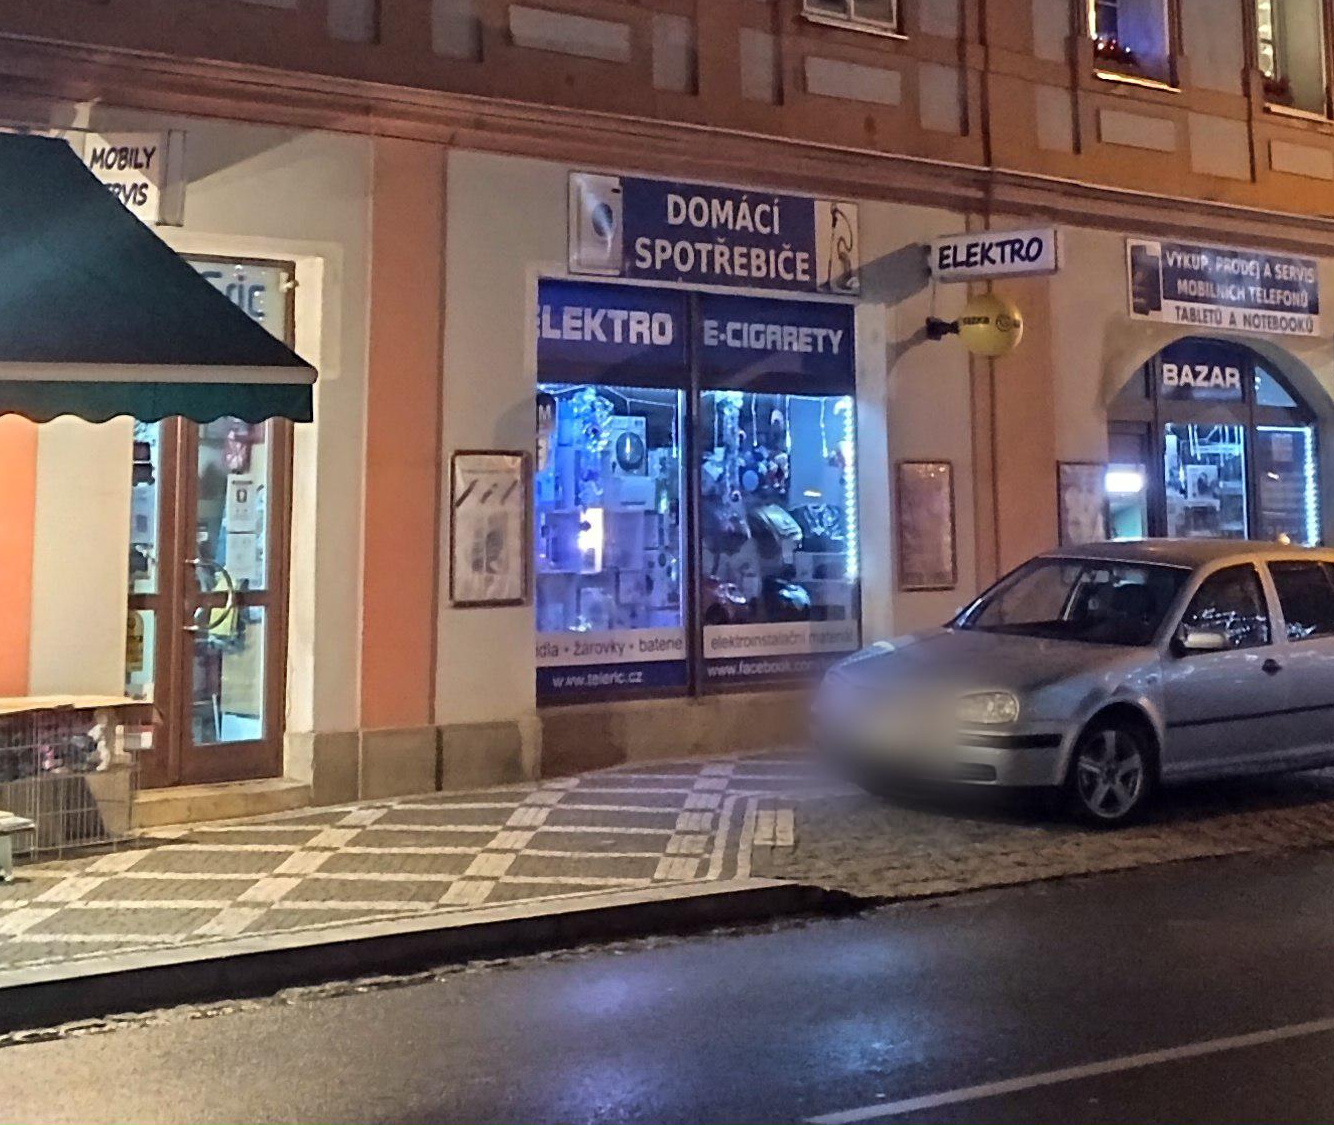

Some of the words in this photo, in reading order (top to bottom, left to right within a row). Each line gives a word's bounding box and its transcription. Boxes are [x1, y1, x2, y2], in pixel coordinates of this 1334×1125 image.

[89, 146, 157, 170] MOBILY
[667, 194, 781, 235] DOMÁCÍ
[634, 237, 811, 281] SPOTŘEBIČE
[938, 237, 1044, 269] ELEKTRO
[1264, 261, 1272, 278] A
[1274, 263, 1315, 283] SERVIS
[1249, 286, 1309, 308] TELEFONŮ
[536, 304, 673, 346] LEKTRO
[703, 320, 844, 355] E-CIGARETY
[1175, 305, 1223, 325] TABLETŮ
[1229, 311, 1237, 326] A
[1243, 312, 1314, 333] NOTEBOOKŮ
[1162, 363, 1241, 389] BAZAR
